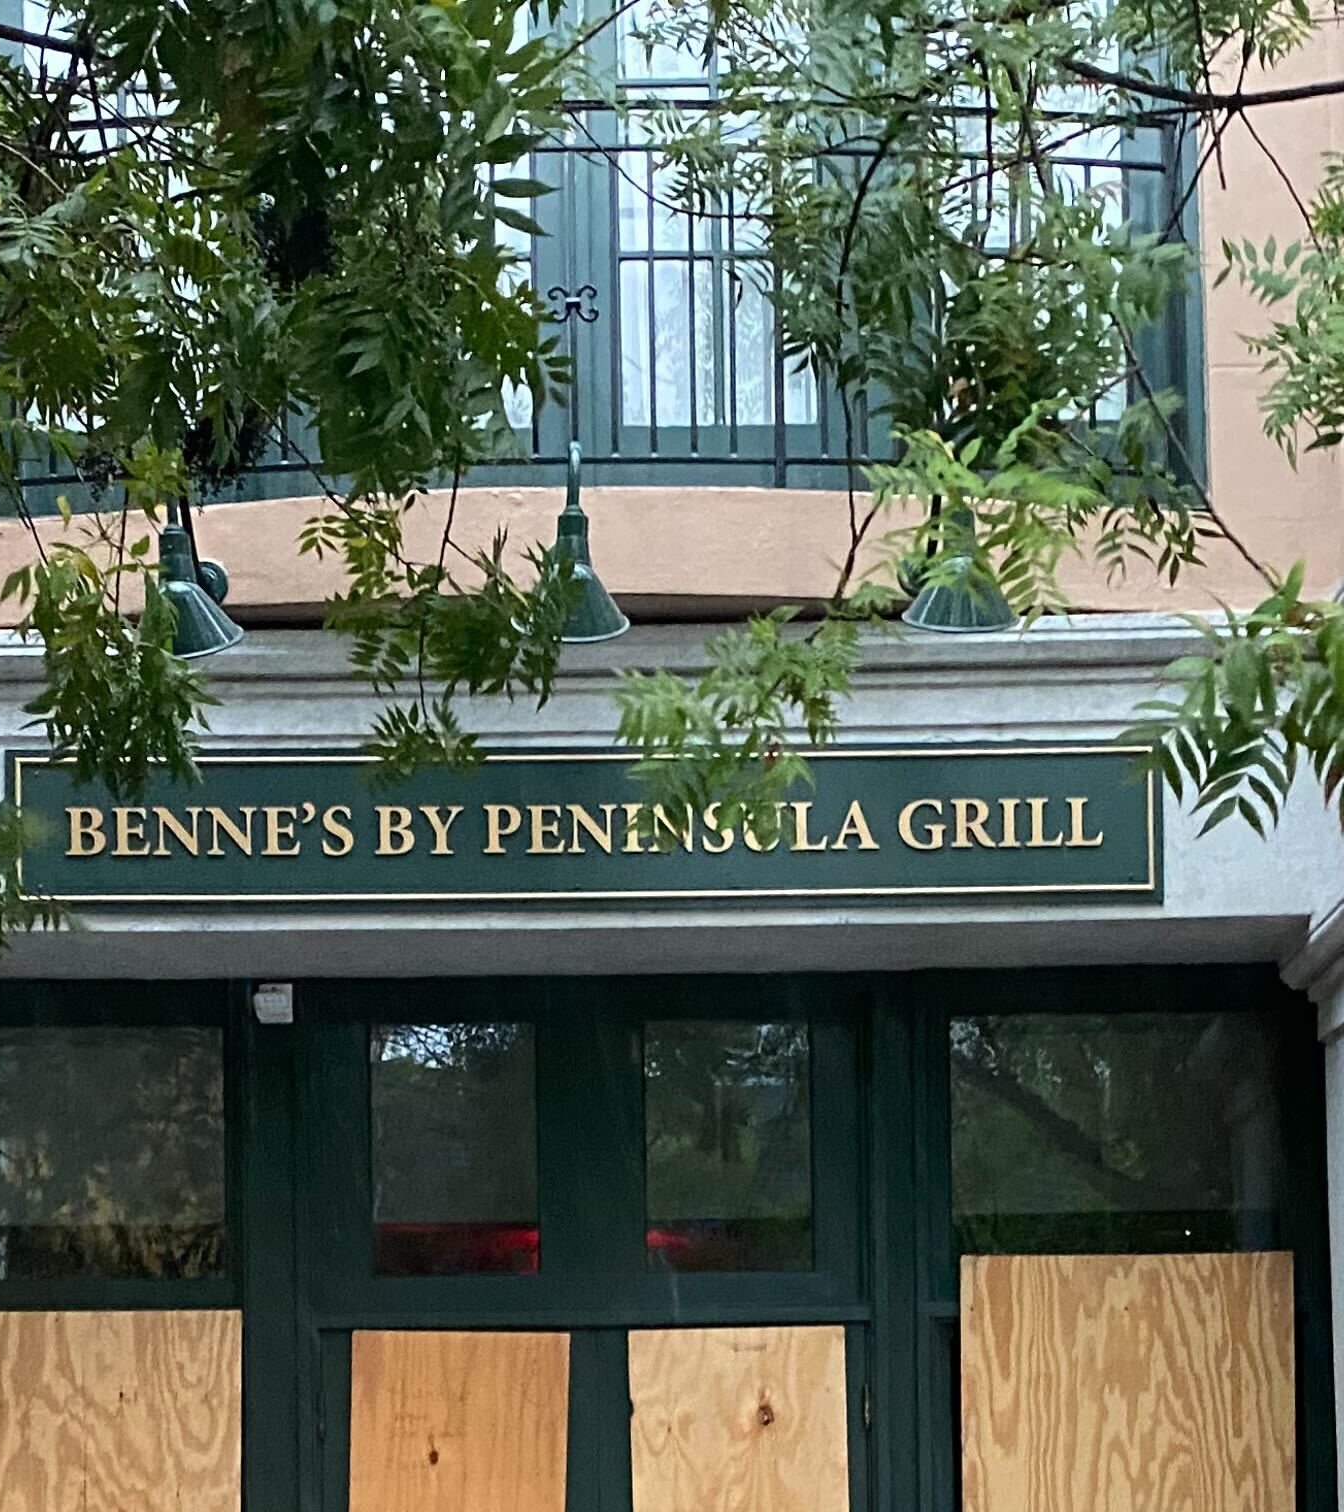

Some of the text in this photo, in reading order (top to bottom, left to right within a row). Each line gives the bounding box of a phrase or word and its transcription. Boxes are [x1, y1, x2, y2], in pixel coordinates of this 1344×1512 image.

[64, 802, 355, 856] BENNE'S
[374, 804, 464, 856] BY
[897, 796, 1104, 851] GRILL
